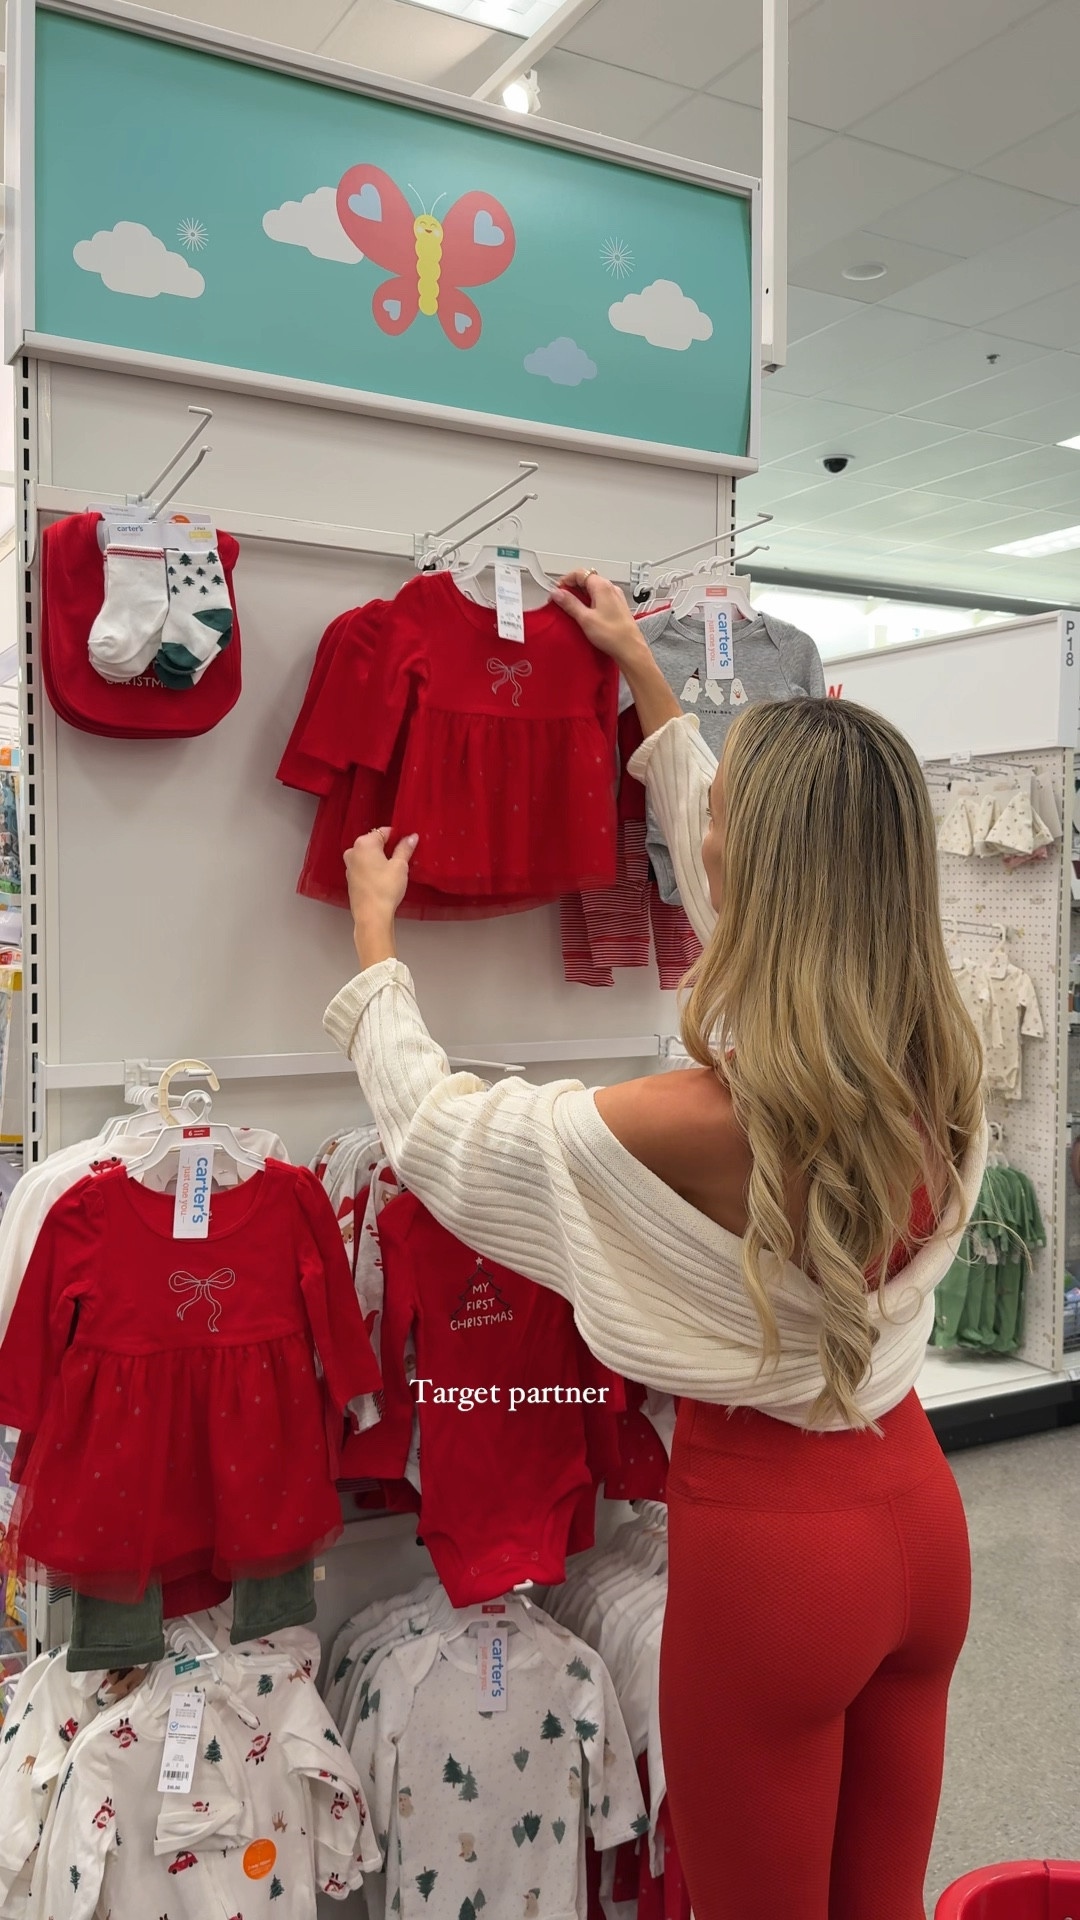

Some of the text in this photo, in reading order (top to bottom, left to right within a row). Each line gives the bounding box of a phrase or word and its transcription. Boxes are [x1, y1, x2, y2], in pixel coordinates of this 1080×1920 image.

[718, 612, 732, 667] carter's
[192, 1157, 209, 1223] carter's
[179, 1199, 188, 1216] you
[472, 1282, 490, 1294] MY
[466, 1297, 495, 1312] FIRST
[450, 1310, 513, 1331] CHRISTMAS
[491, 1638, 505, 1697] carter's
